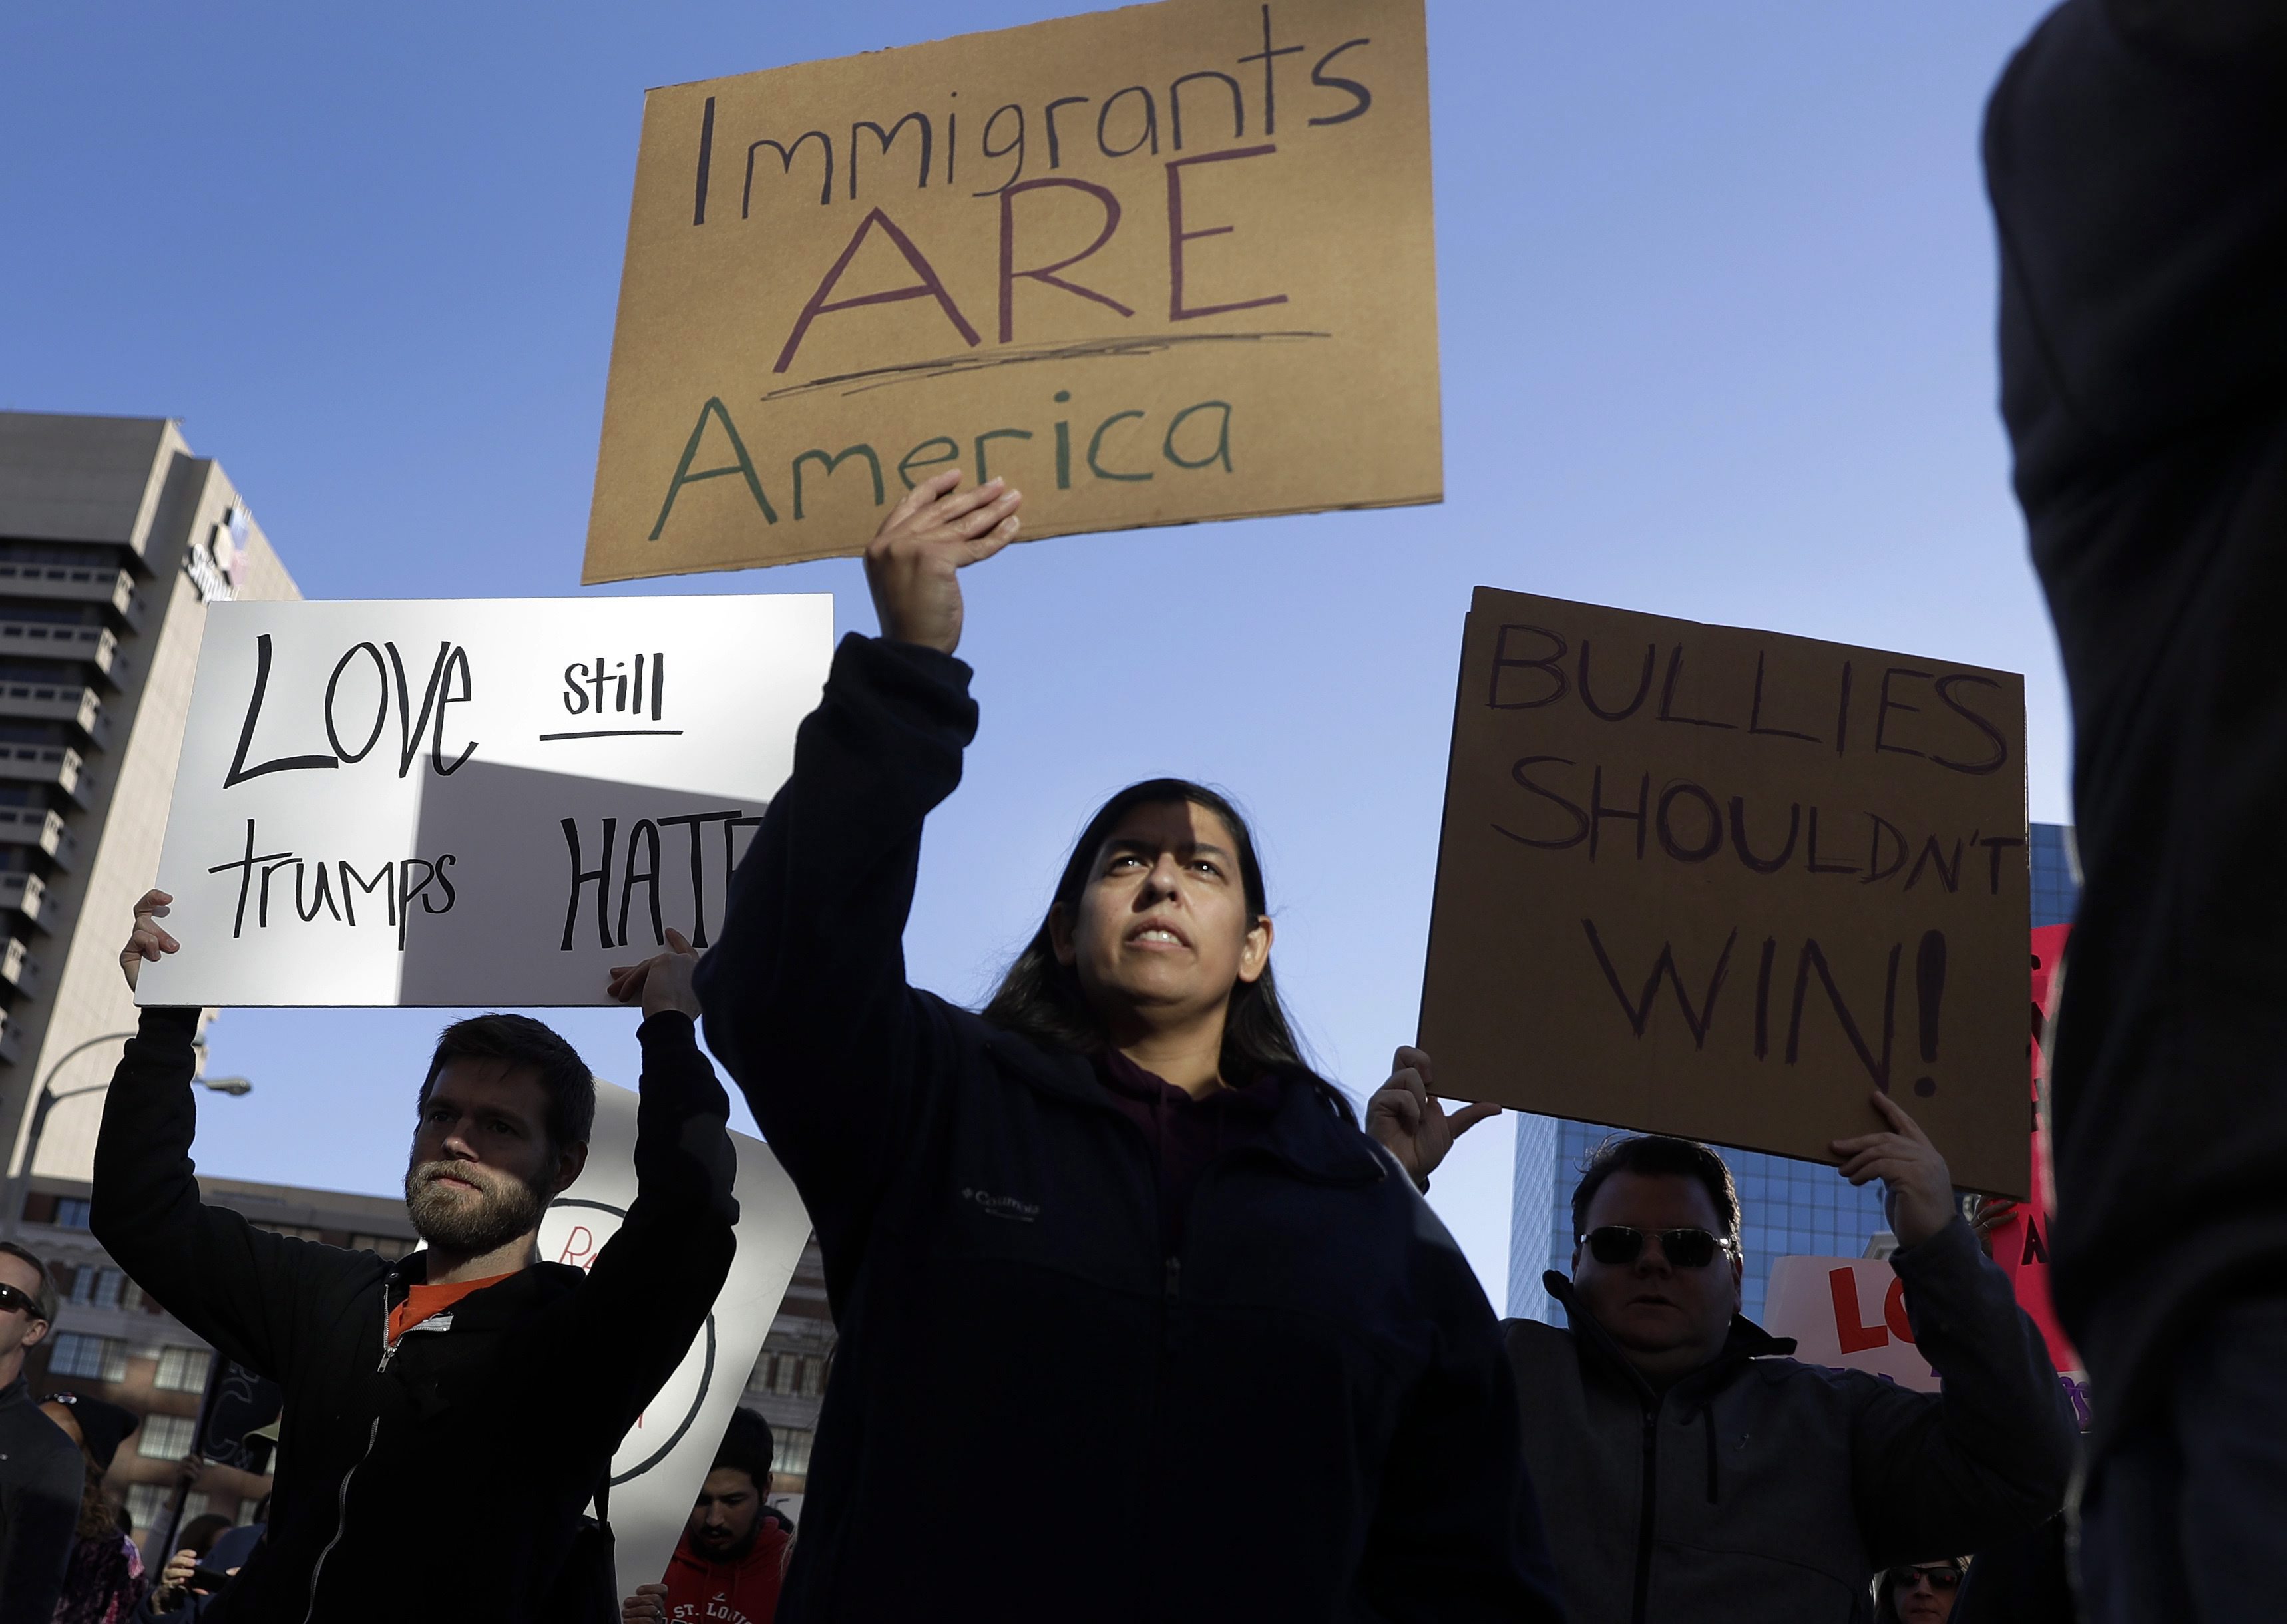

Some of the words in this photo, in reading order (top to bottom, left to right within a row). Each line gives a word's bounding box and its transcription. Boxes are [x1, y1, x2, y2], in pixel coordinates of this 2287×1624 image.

[692, 4, 1372, 226] Immigrants
[773, 144, 1289, 373] ARE
[652, 390, 1233, 540] America
[563, 652, 664, 721] still
[1485, 624, 2008, 775] BULLIES
[1489, 755, 2025, 895] SHOULDN'T
[1581, 918, 1947, 1098] WIN!
[673, 1603, 700, 1619] ST.
